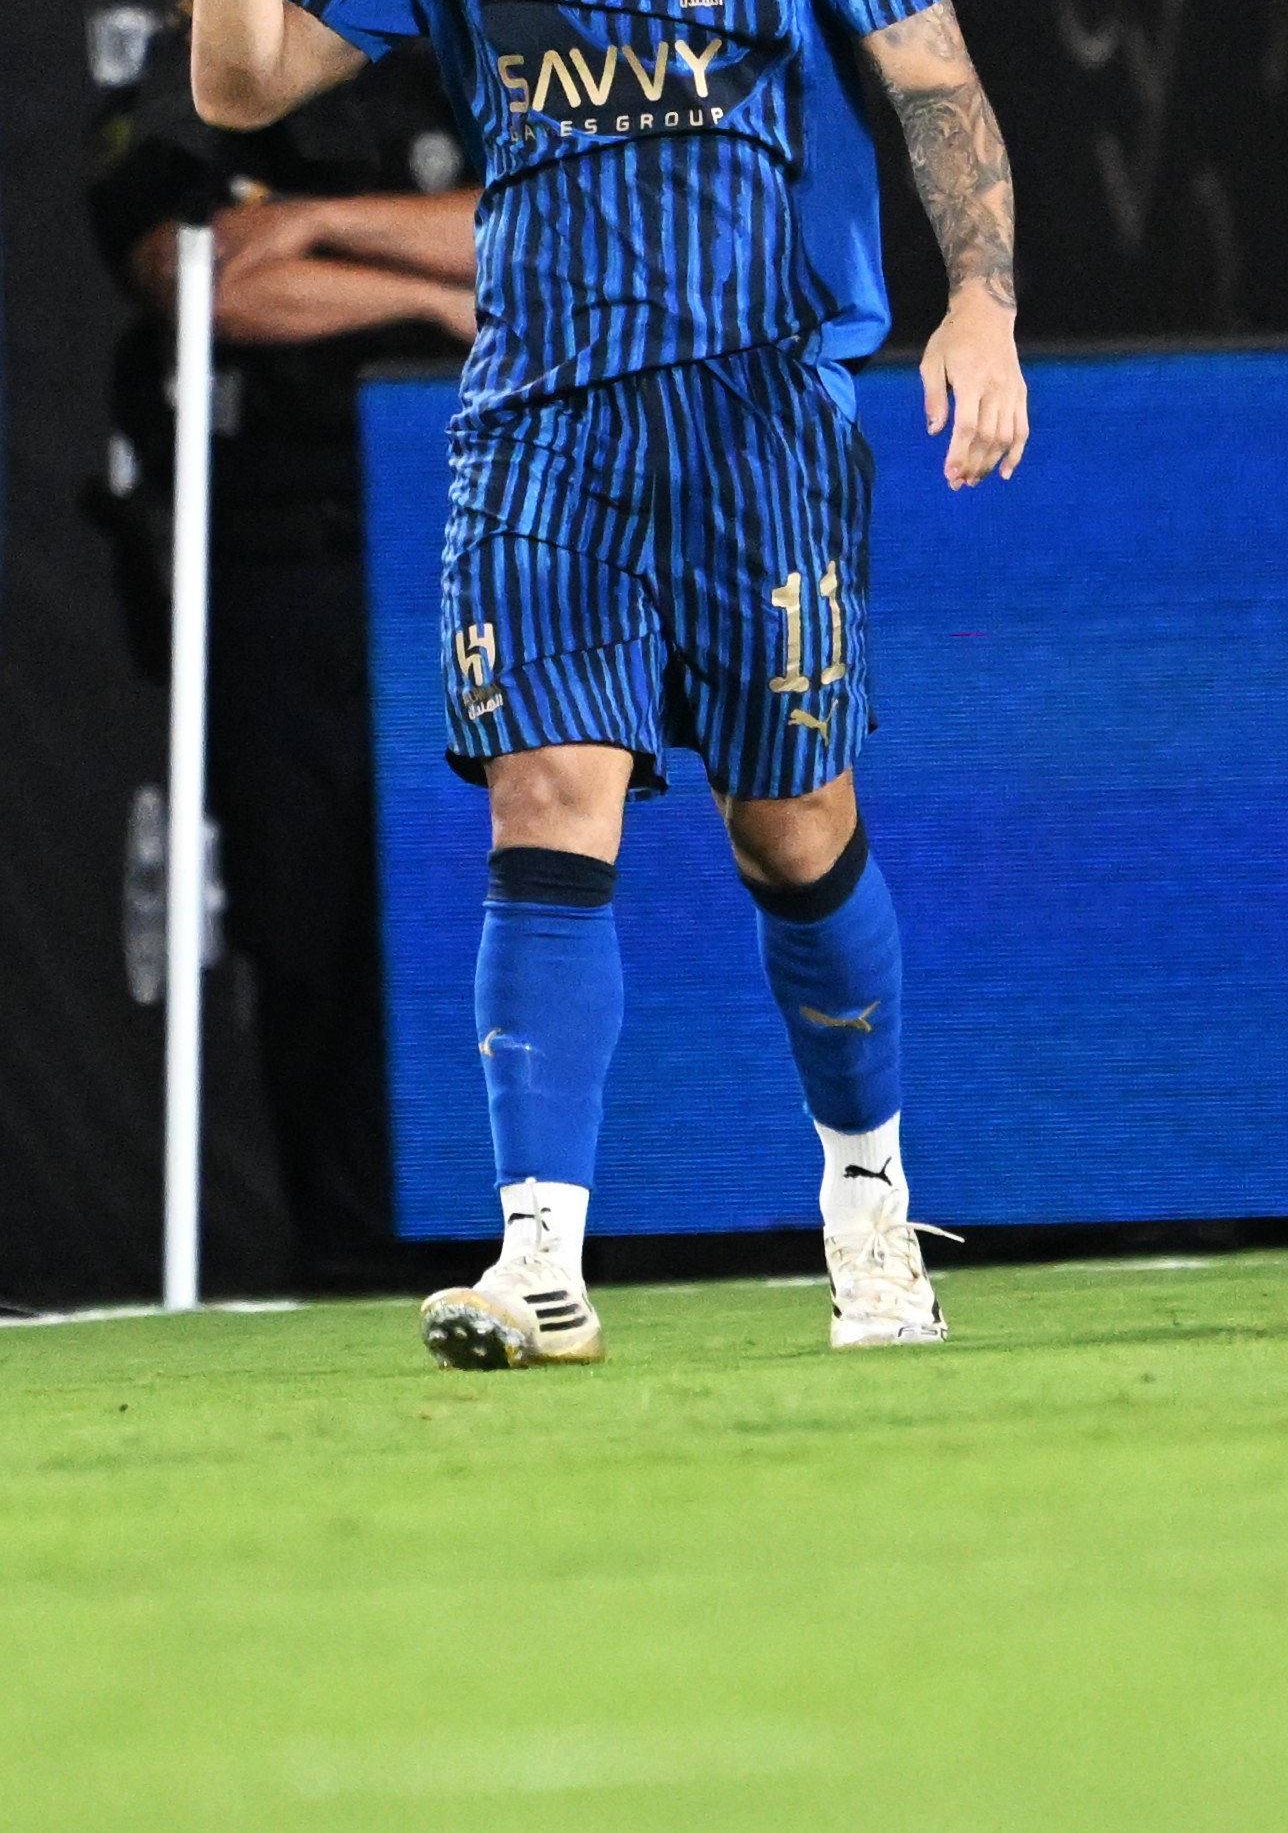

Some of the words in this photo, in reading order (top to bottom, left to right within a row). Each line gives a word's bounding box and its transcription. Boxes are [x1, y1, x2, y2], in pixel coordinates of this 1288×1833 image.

[497, 38, 723, 113] SAVVY
[615, 107, 724, 132] GROUP
[769, 560, 846, 693] 11
